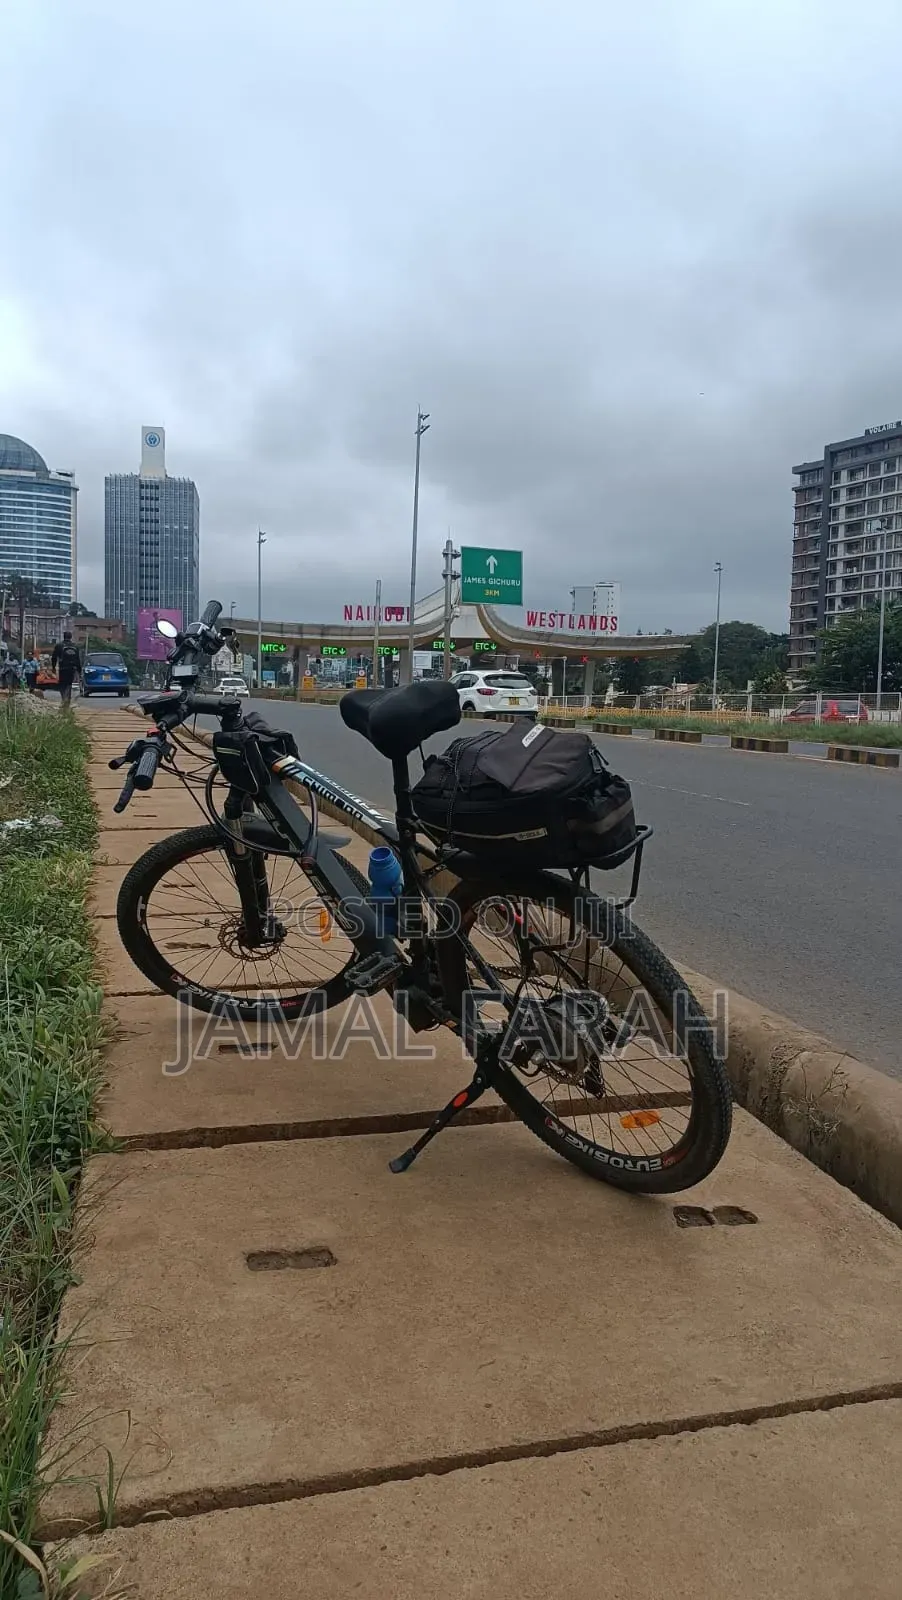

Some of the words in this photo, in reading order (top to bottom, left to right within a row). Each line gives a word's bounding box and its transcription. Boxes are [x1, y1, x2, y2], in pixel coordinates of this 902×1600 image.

[464, 576, 486, 585] JAMES
[488, 577, 521, 587] GICHURU
[484, 589, 500, 597] 3KM
[526, 610, 618, 631] WESTLANDS
[261, 643, 279, 652] MTC
[322, 646, 338, 655] ETC
[475, 642, 490, 650] ETC
[564, 1132, 663, 1173] EUROBIKE
